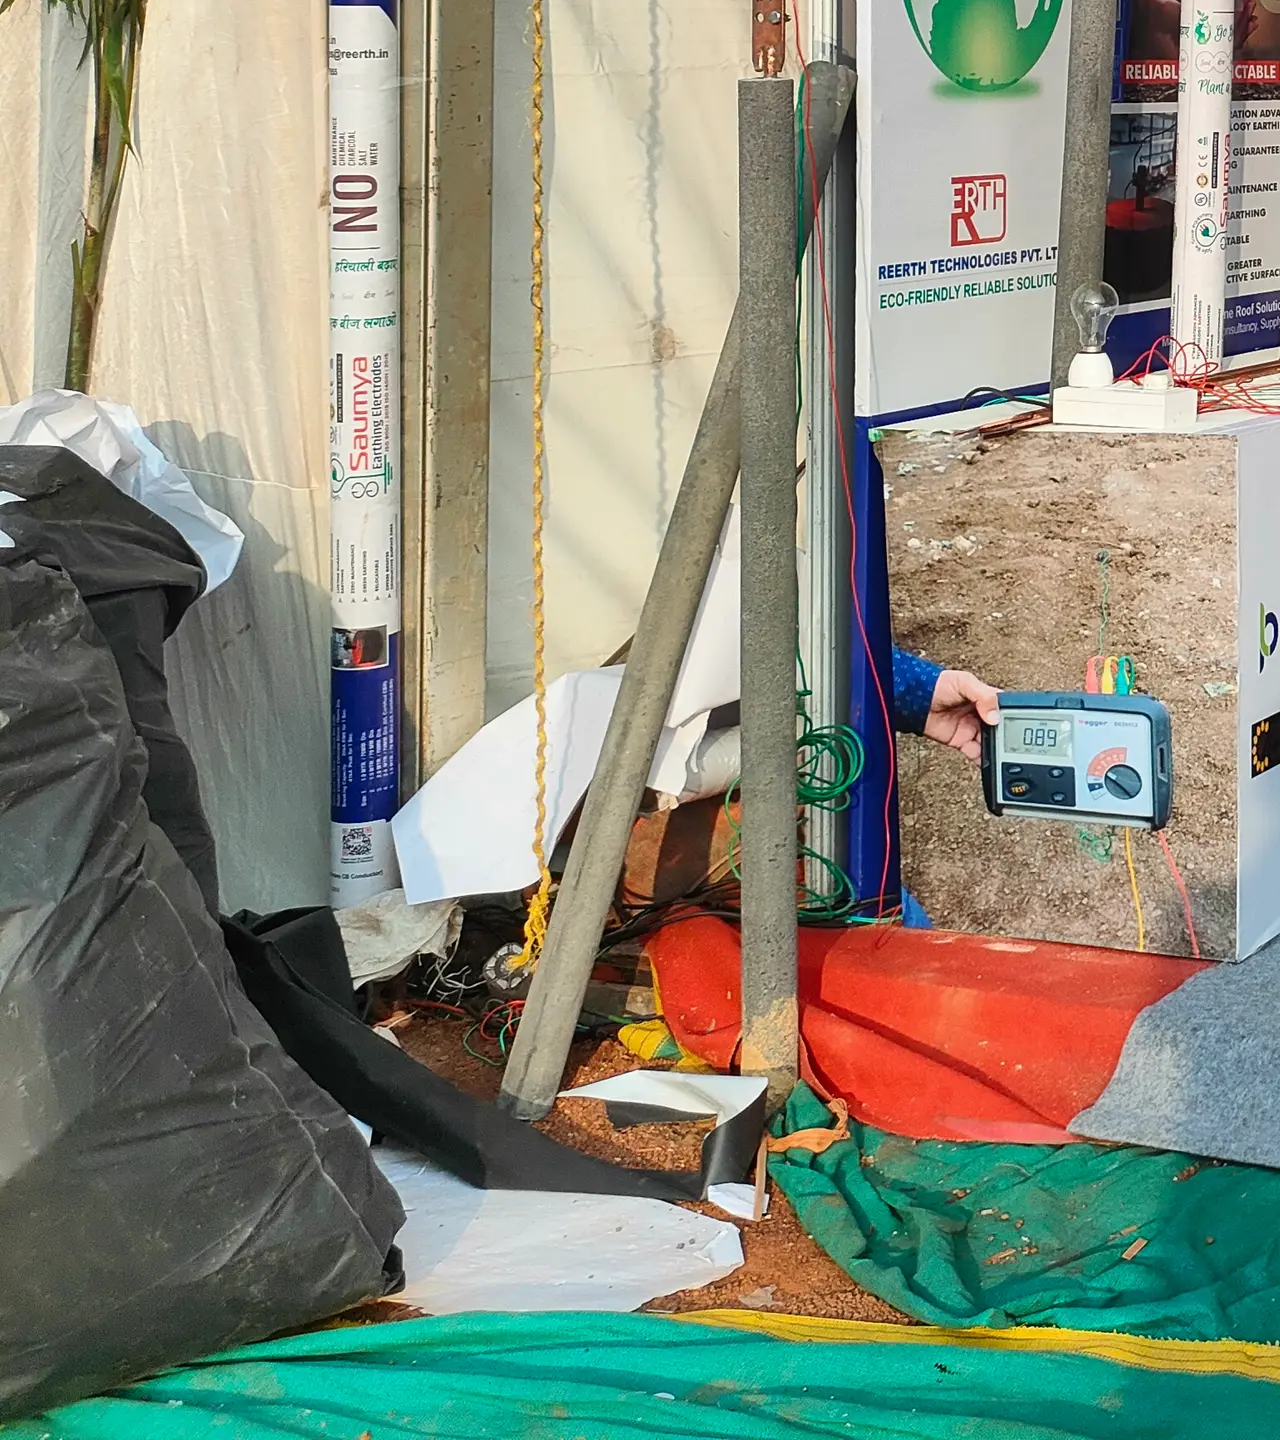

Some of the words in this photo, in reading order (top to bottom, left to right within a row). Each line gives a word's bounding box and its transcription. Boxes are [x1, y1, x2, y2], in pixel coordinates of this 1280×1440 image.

[332, 173, 378, 233] NO
[878, 259, 927, 280] REERTH
[930, 251, 1017, 273] TECHNOLOGIES
[1020, 248, 1042, 264] PVT.
[1046, 246, 1058, 260] LT
[879, 285, 961, 309] ECO-FRIENDLY
[964, 277, 1014, 298] RELIABLE
[1016, 273, 1058, 291] SOLUTIO
[349, 356, 369, 471] Saumya
